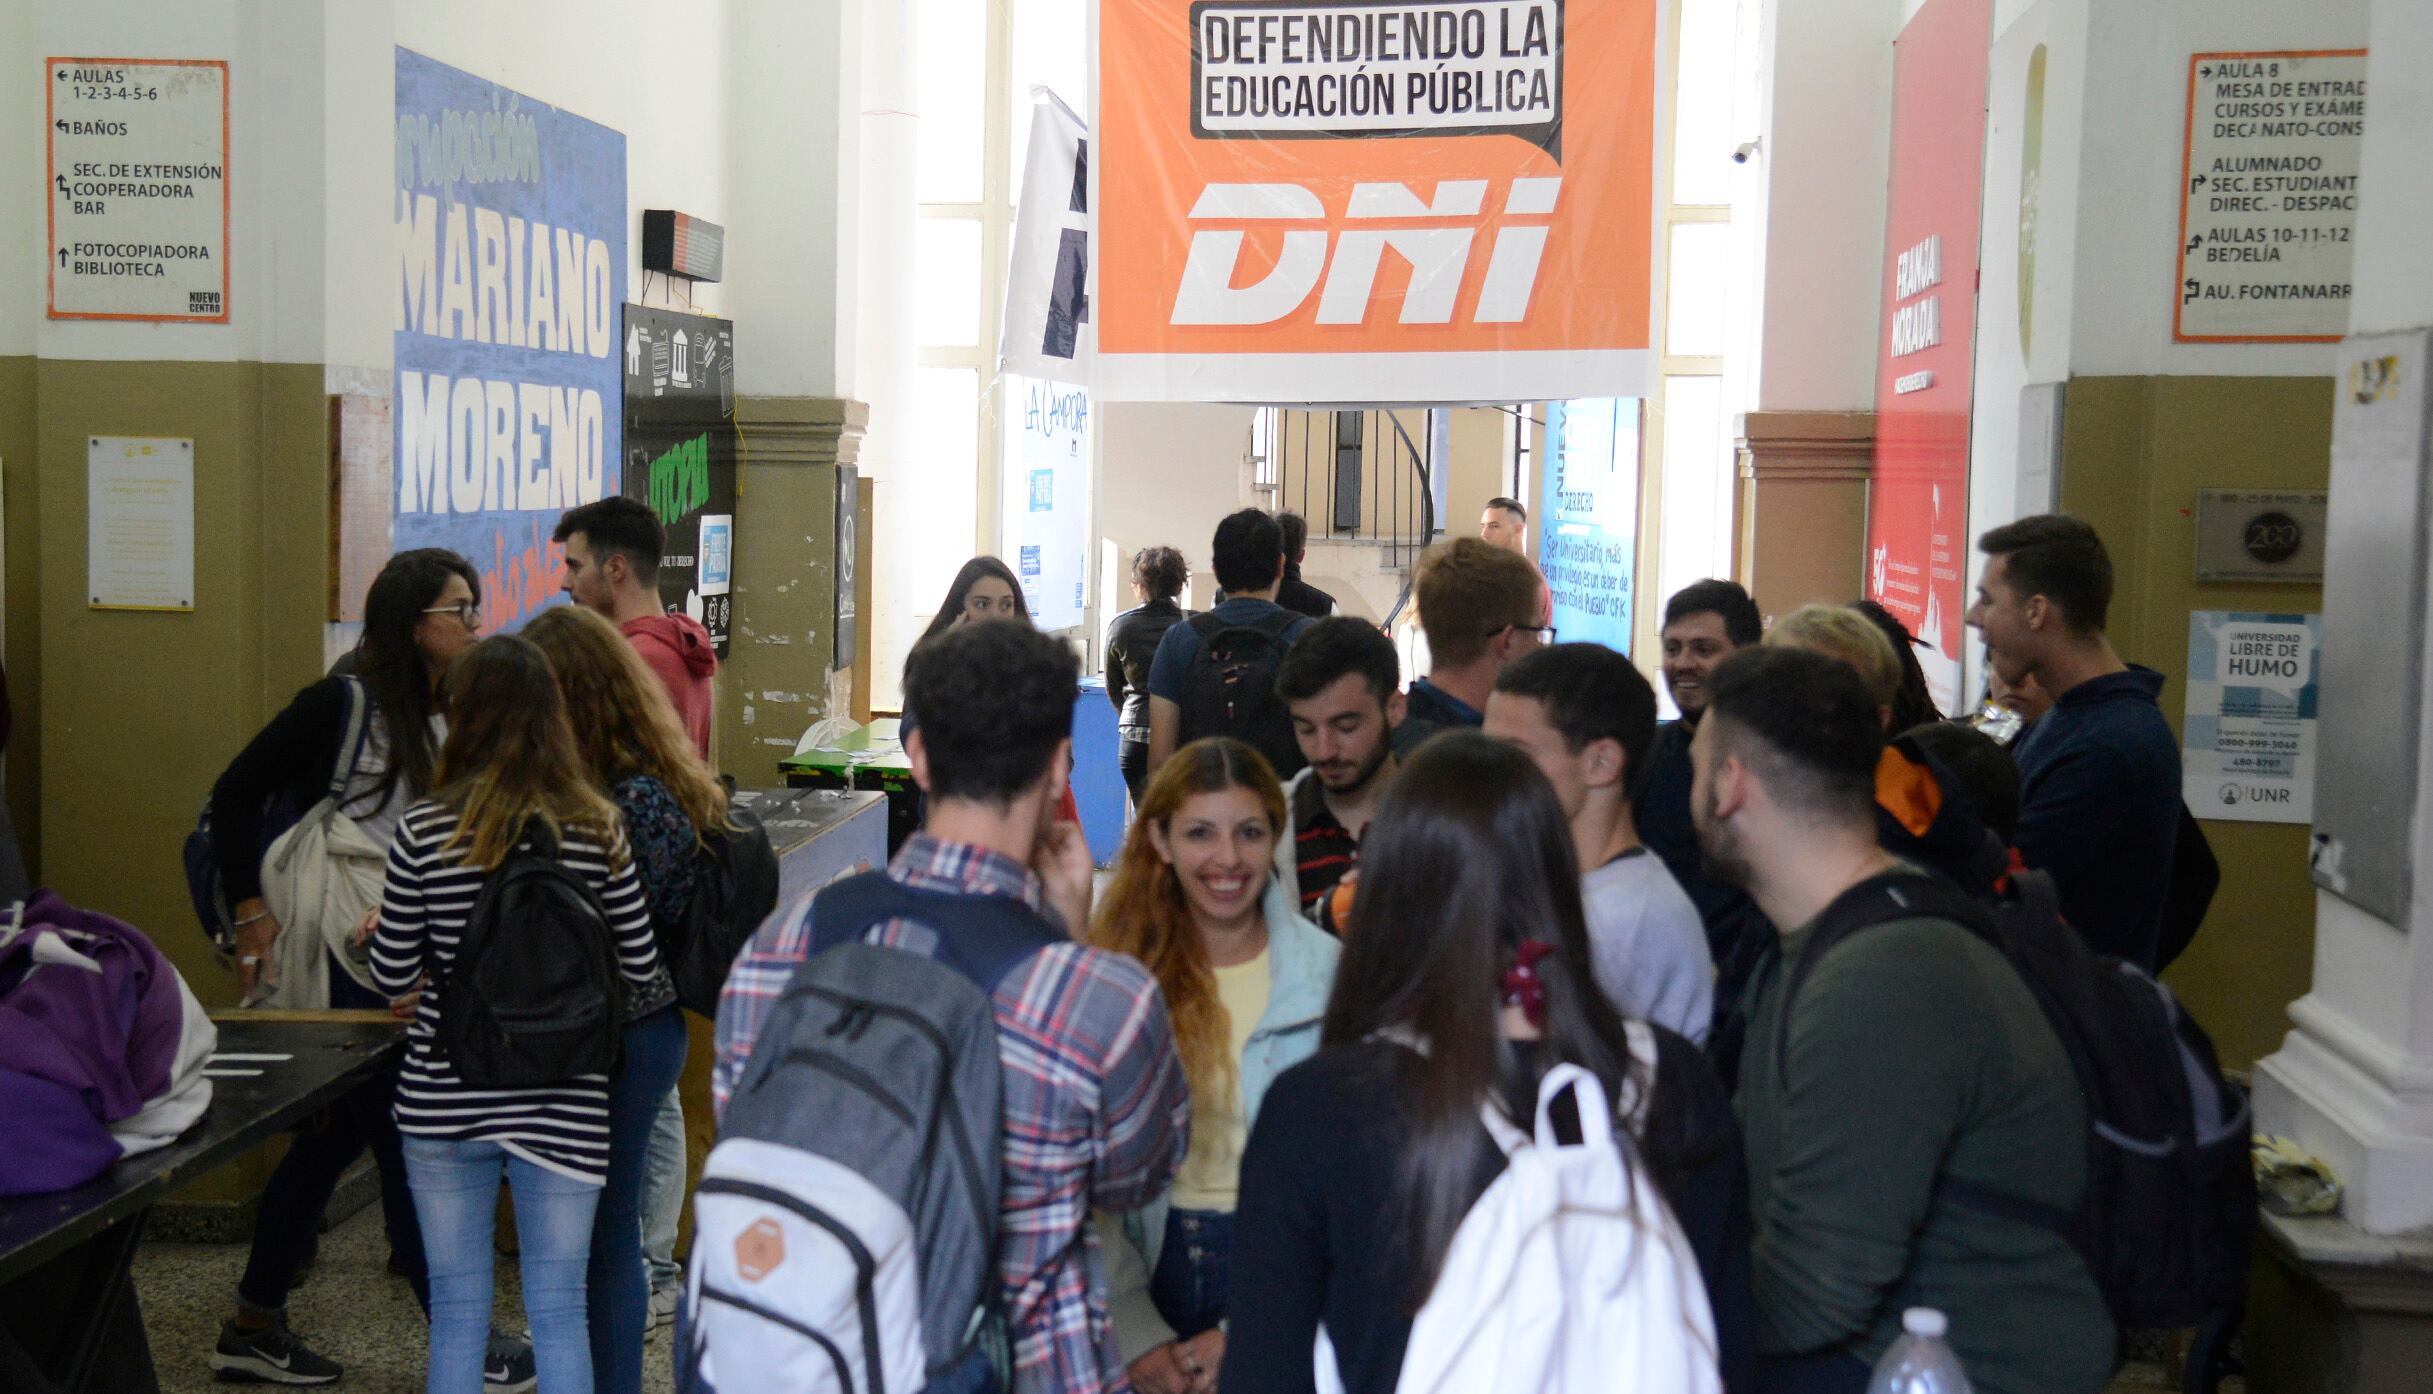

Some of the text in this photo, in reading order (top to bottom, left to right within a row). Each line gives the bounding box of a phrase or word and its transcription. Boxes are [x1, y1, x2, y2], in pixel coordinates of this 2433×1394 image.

[1205, 5, 1549, 64] DEFENDIENDO LA
[73, 69, 125, 84] AULAS
[2217, 63, 2279, 78] AULA 8
[74, 87, 158, 101] 1-2-3-4-5-6
[1205, 62, 1550, 117] EDUCACIÓN PÚBLICA
[2216, 83, 2264, 98] MESA
[2270, 82, 2291, 97] DE
[2215, 99, 2365, 118] CURSOS Y EXÁME
[73, 119, 128, 136] BAÑOS
[74, 162, 222, 180] SEC. DE EXTENSIÓN
[2212, 156, 2322, 173] ALUMNADO
[74, 183, 194, 199] COOPERADORA
[2211, 176, 2358, 192] SEC. ESTUDIANT
[74, 201, 105, 215] BAR
[2210, 197, 2268, 212] DIREC.
[2283, 196, 2355, 212] DESPAC
[2207, 227, 2349, 243] AULAS 10-11-12
[74, 243, 209, 260] FOTOCOPIADORA
[2207, 247, 2280, 262] BEDELÍA
[74, 262, 164, 277] BIBLIOTECA
[395, 191, 611, 358] MARIANO
[1896, 235, 1936, 301] FRANJA
[190, 292, 220, 304] NUEVO
[2204, 285, 2235, 300] AU.
[190, 304, 220, 313] CENTRO
[1891, 296, 1935, 357] MORADA
[401, 371, 602, 514] MORENO
[2230, 632, 2301, 643] UNIVERSIDAD
[2230, 643, 2299, 657] LIBRE DE
[2229, 658, 2298, 677] HUMO
[2251, 788, 2290, 803] UNR
